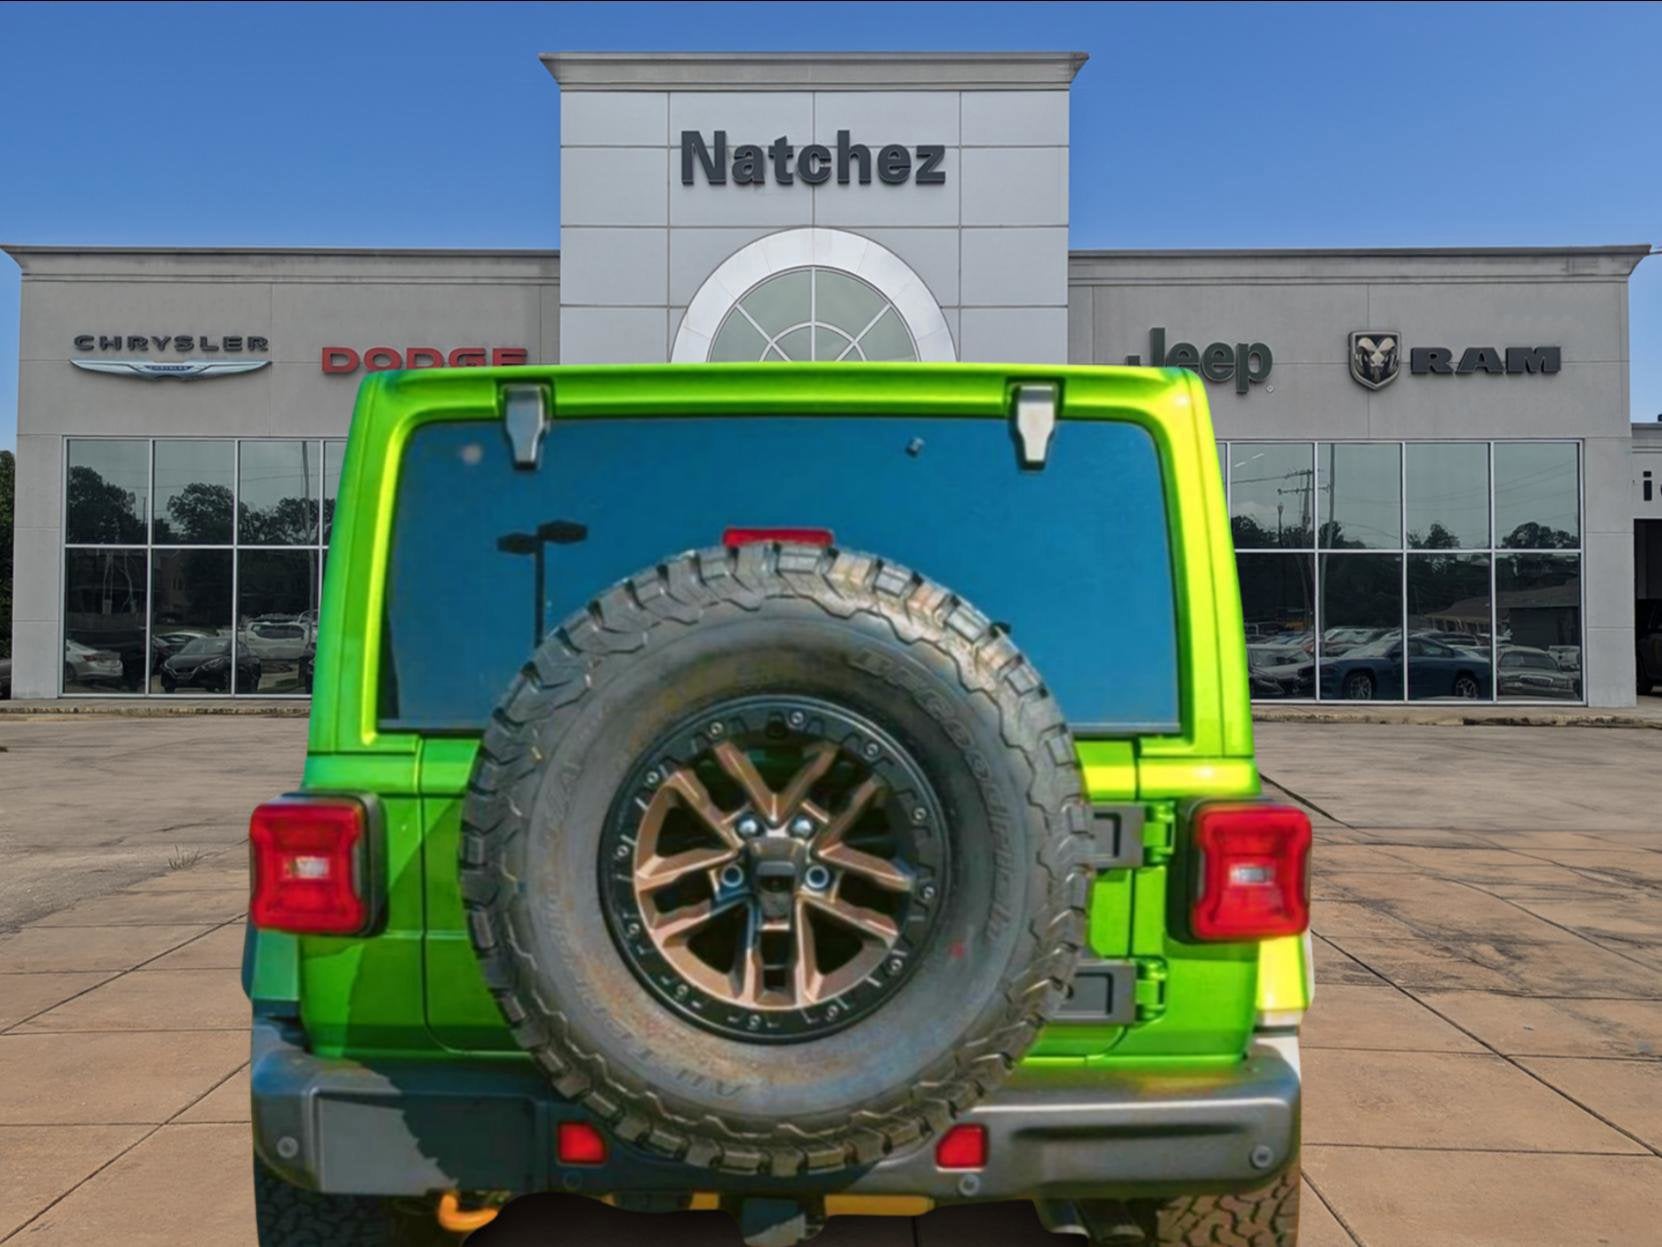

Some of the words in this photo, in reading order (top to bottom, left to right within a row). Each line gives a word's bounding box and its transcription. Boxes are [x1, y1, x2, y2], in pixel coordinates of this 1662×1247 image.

[681, 130, 946, 185] Natchez
[74, 335, 269, 352] CHRYSLER
[322, 347, 527, 374] DODGE
[1410, 346, 1562, 375] RAM
